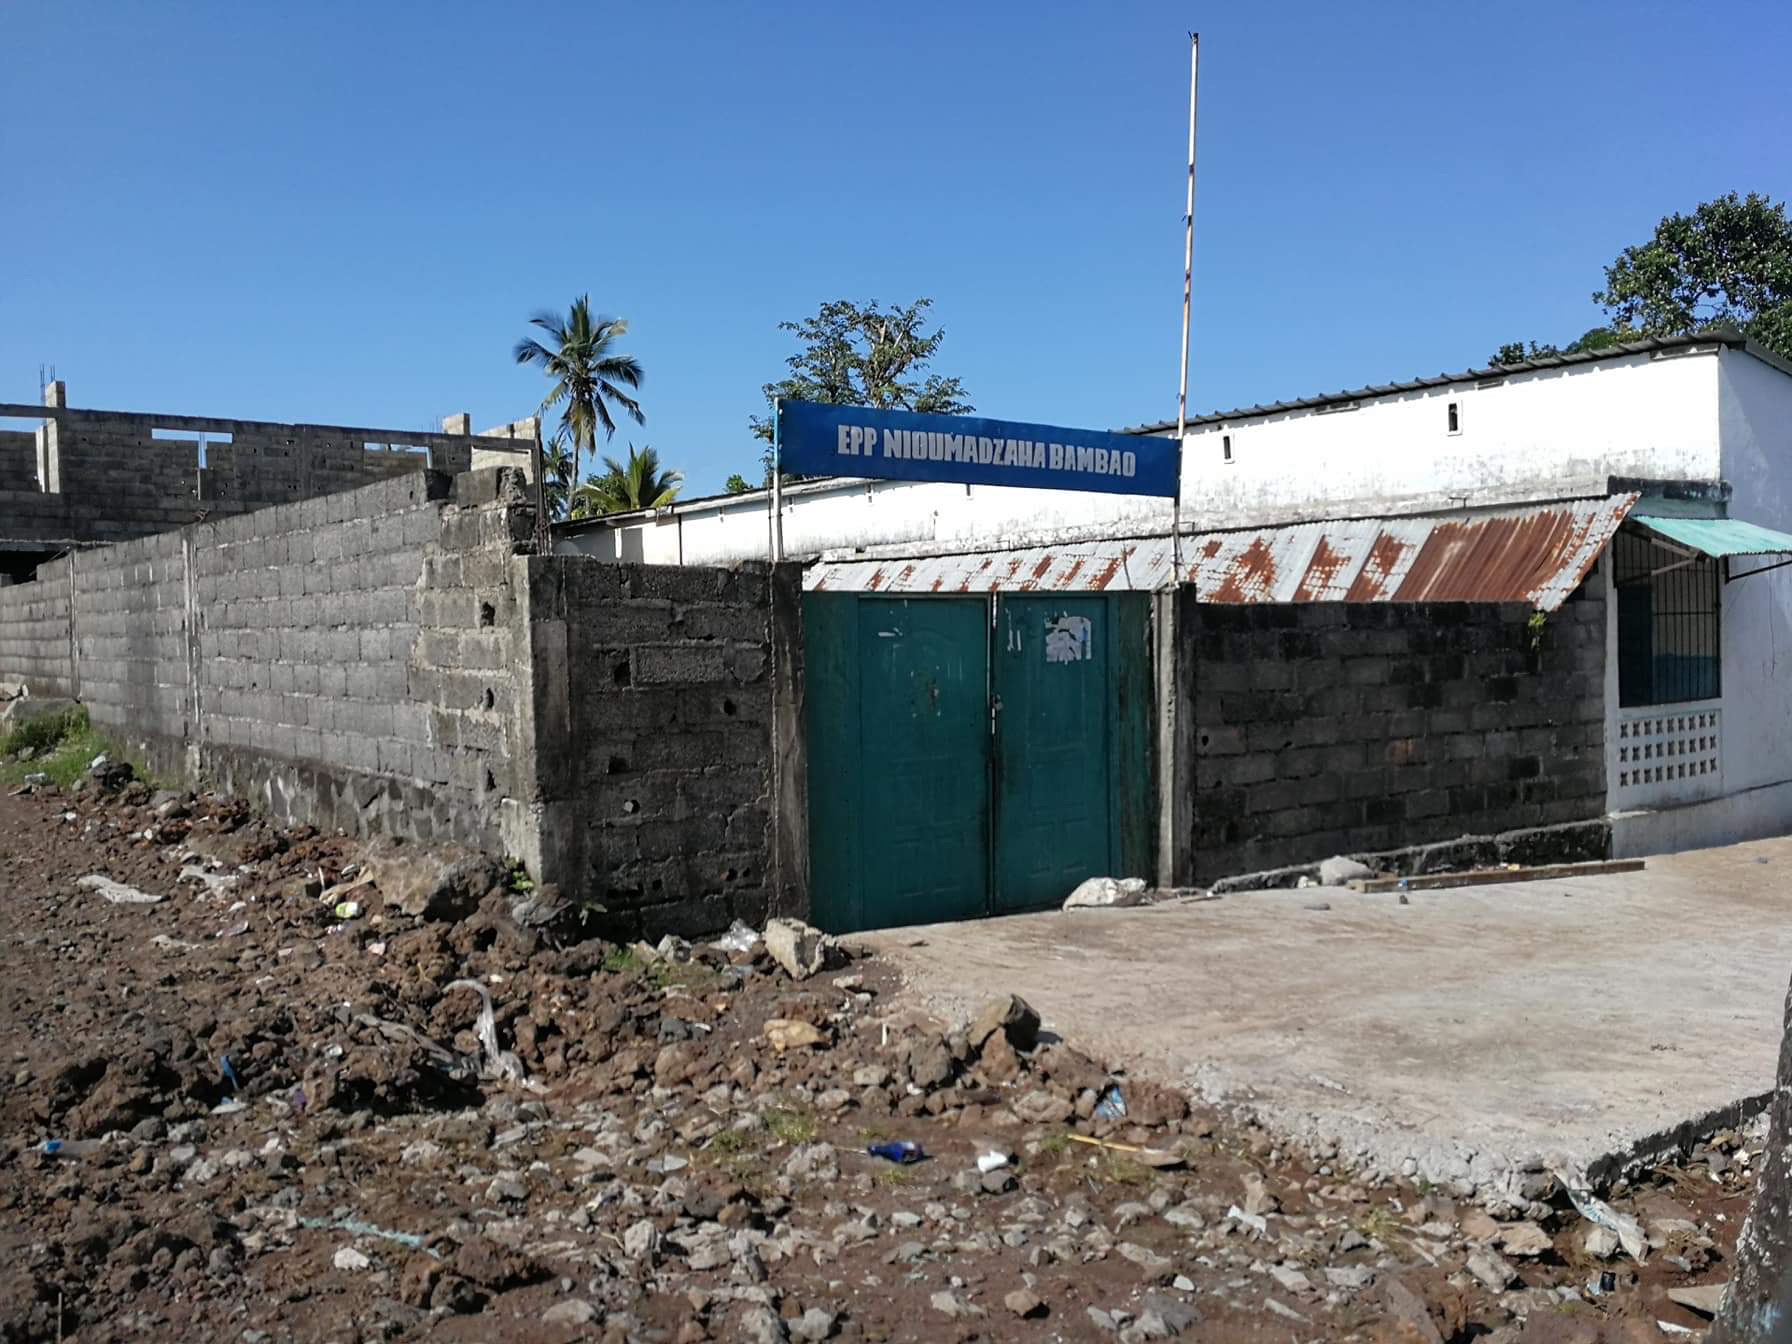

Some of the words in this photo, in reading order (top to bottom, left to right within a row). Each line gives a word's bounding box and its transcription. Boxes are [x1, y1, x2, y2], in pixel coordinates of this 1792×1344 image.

[838, 425, 877, 456] EPP
[883, 429, 1046, 469] NIOUMADZAHA
[1049, 443, 1136, 477] BAMBAO
